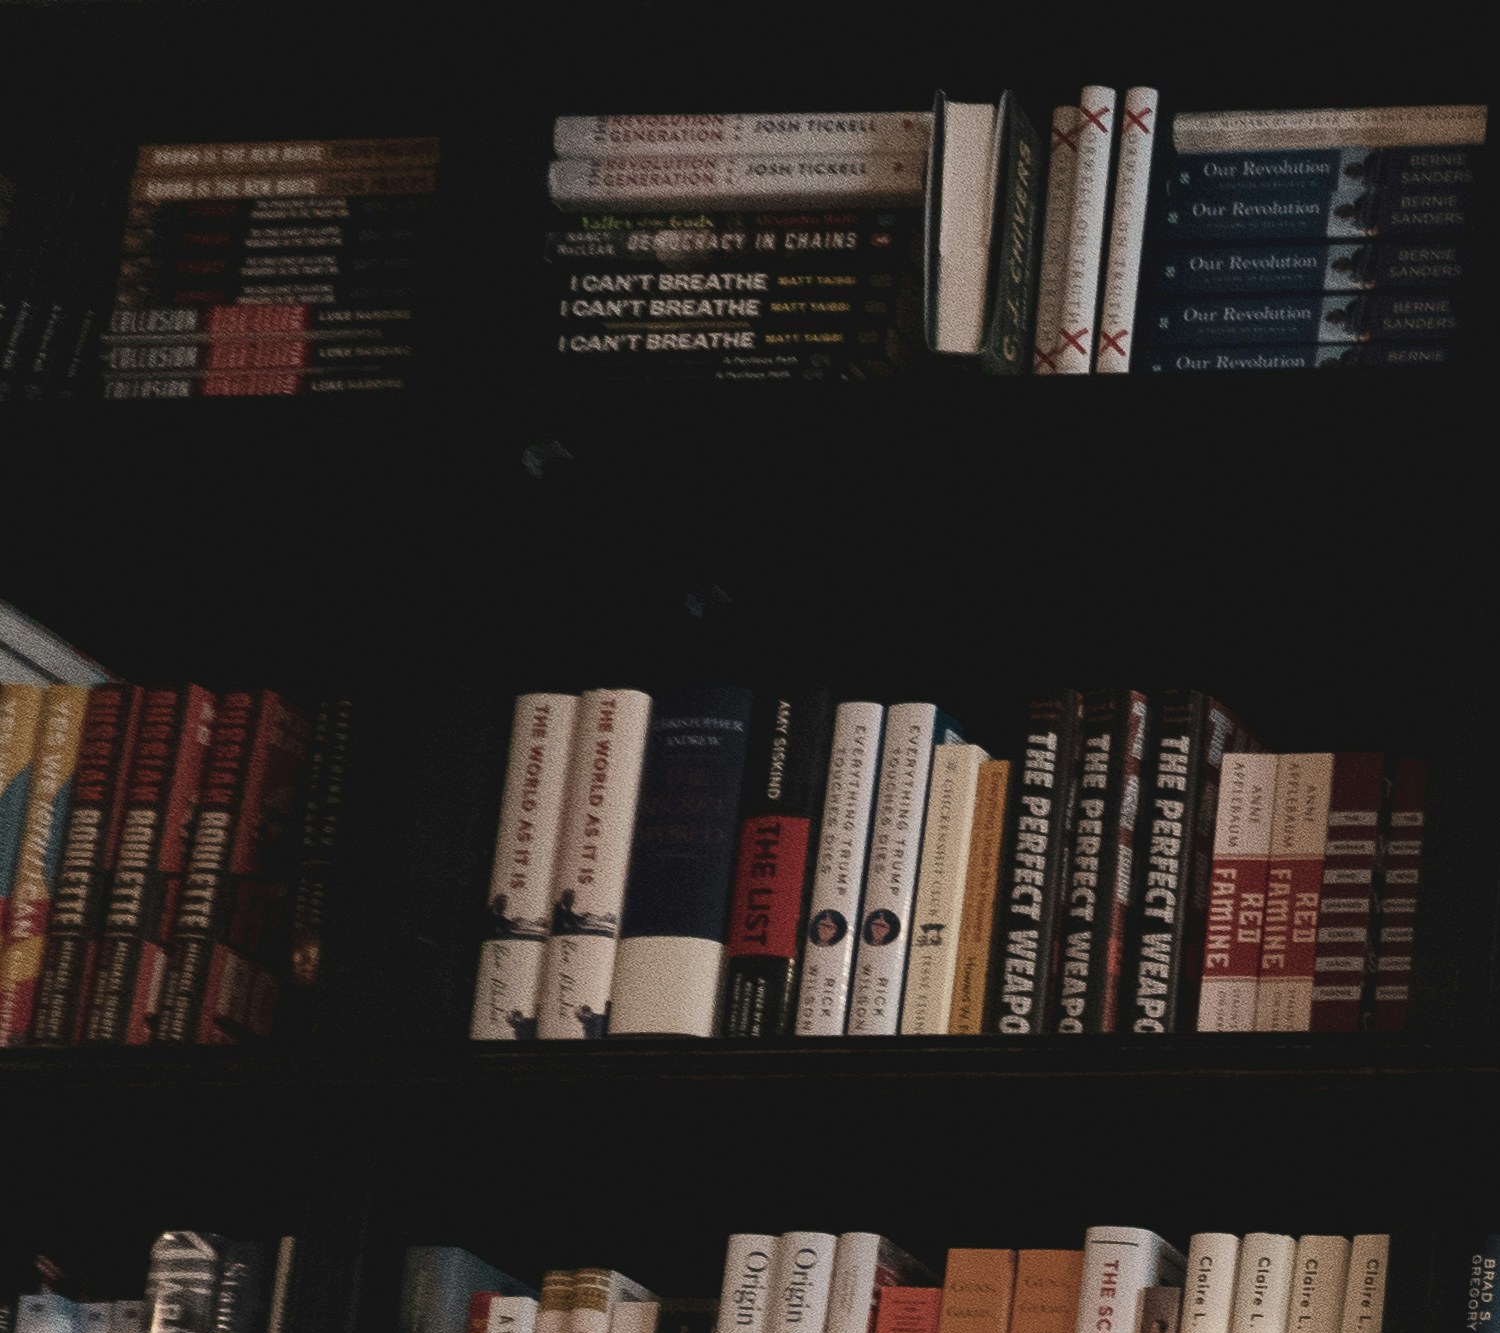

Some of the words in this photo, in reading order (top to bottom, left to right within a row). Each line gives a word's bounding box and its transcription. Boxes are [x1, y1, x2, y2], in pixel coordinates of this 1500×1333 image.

[570, 274, 577, 291] I
[584, 273, 654, 291] CAN'T
[659, 273, 767, 291] BREATHE
[1099, 1258, 1119, 1295] THE
